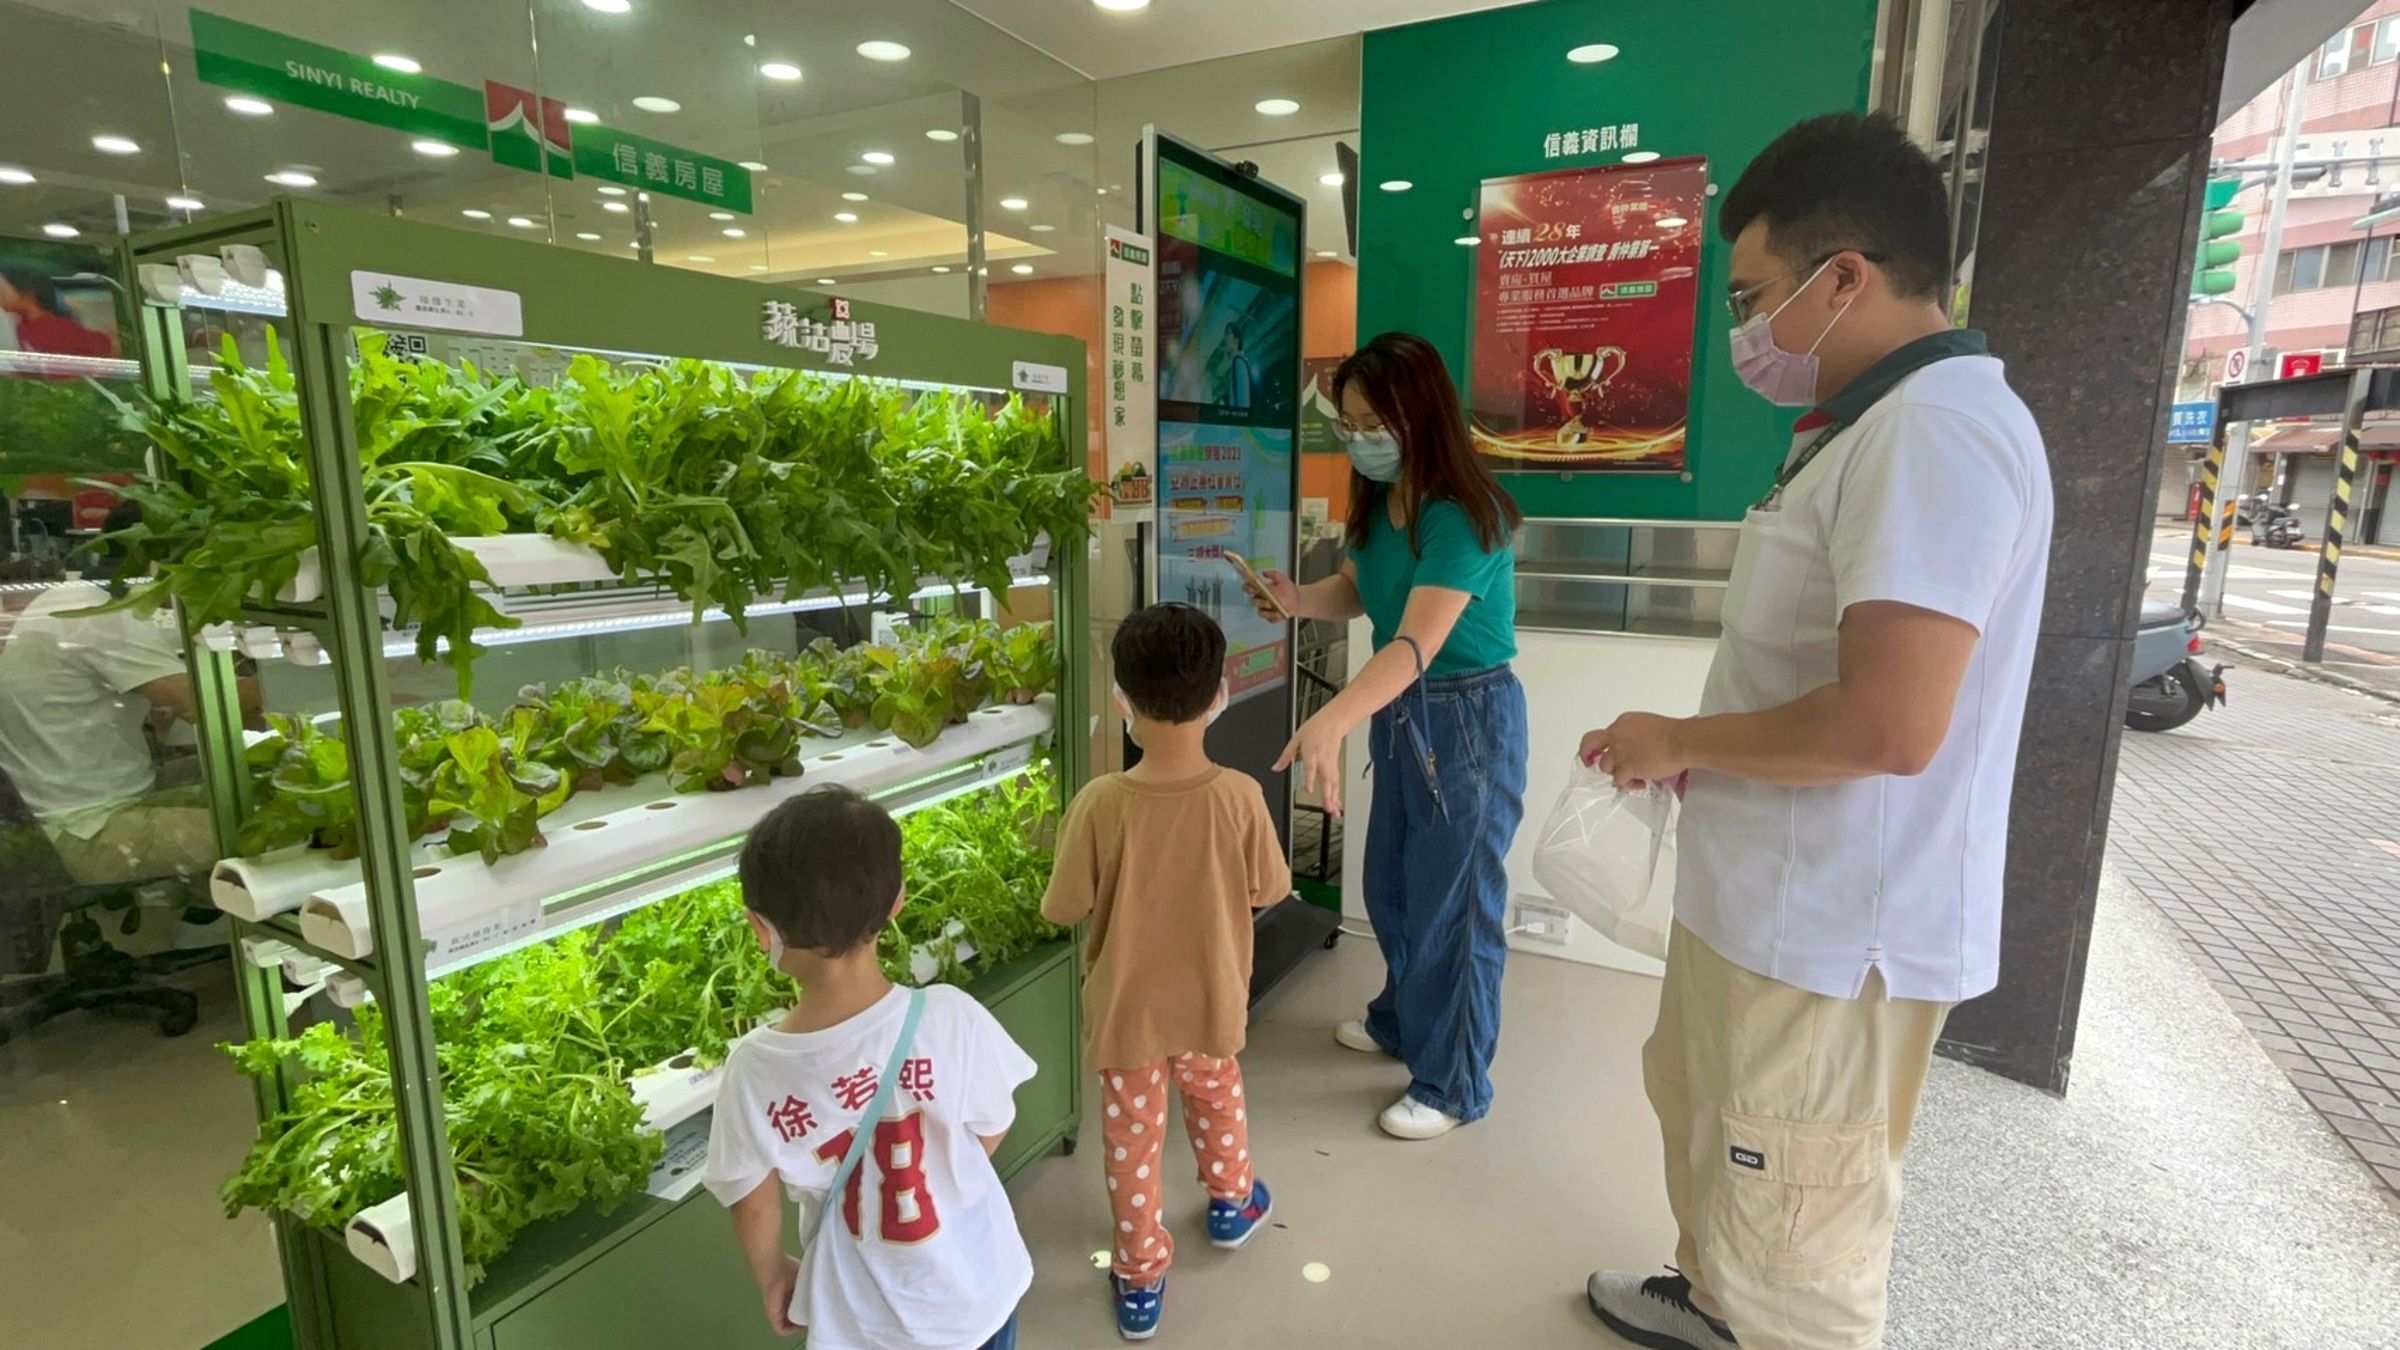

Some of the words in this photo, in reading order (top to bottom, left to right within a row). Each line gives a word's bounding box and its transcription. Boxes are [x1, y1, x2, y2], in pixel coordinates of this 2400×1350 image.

[285, 60, 343, 90] SINYI
[349, 77, 420, 110] REALTY
[1543, 123, 1639, 158] 信義資訊欄
[612, 142, 725, 197] 信義房屋
[812, 1108, 941, 1246] 18
